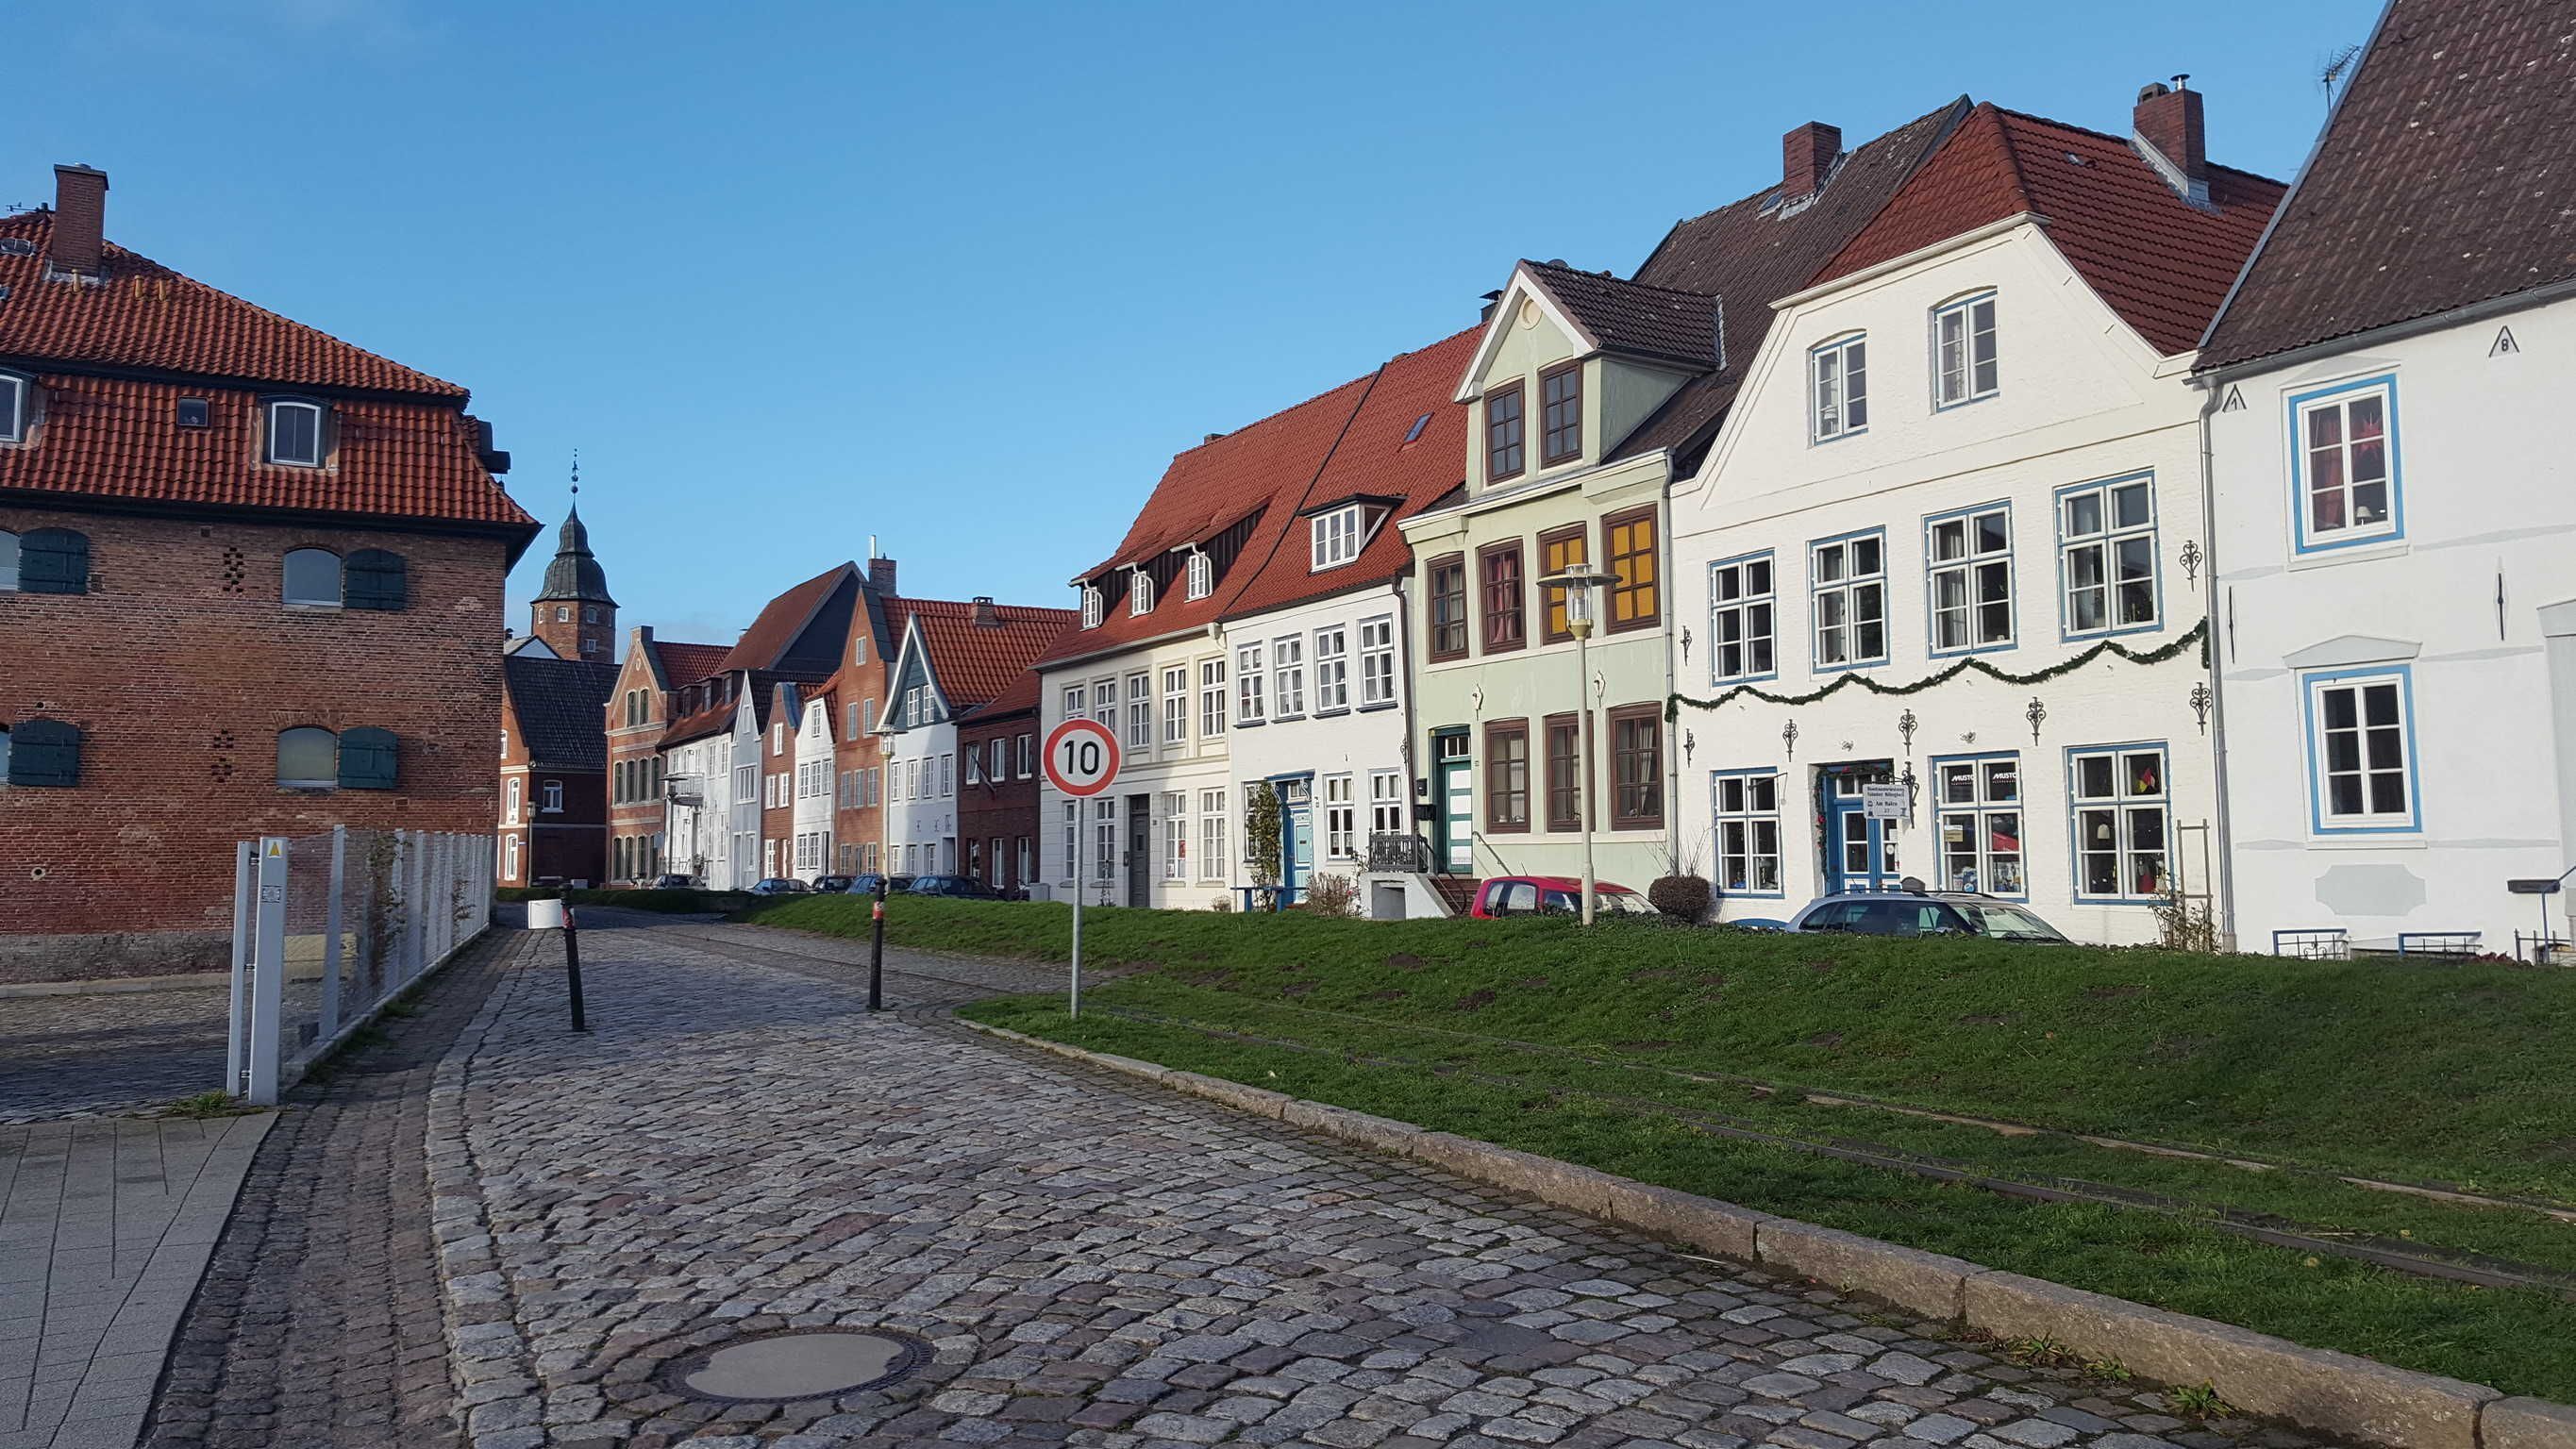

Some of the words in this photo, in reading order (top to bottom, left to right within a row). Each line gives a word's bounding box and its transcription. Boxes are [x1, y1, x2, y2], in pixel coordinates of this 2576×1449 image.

[2501, 339, 2509, 352] 8
[2231, 397, 2237, 410] 1
[1063, 740, 1099, 775] 10
